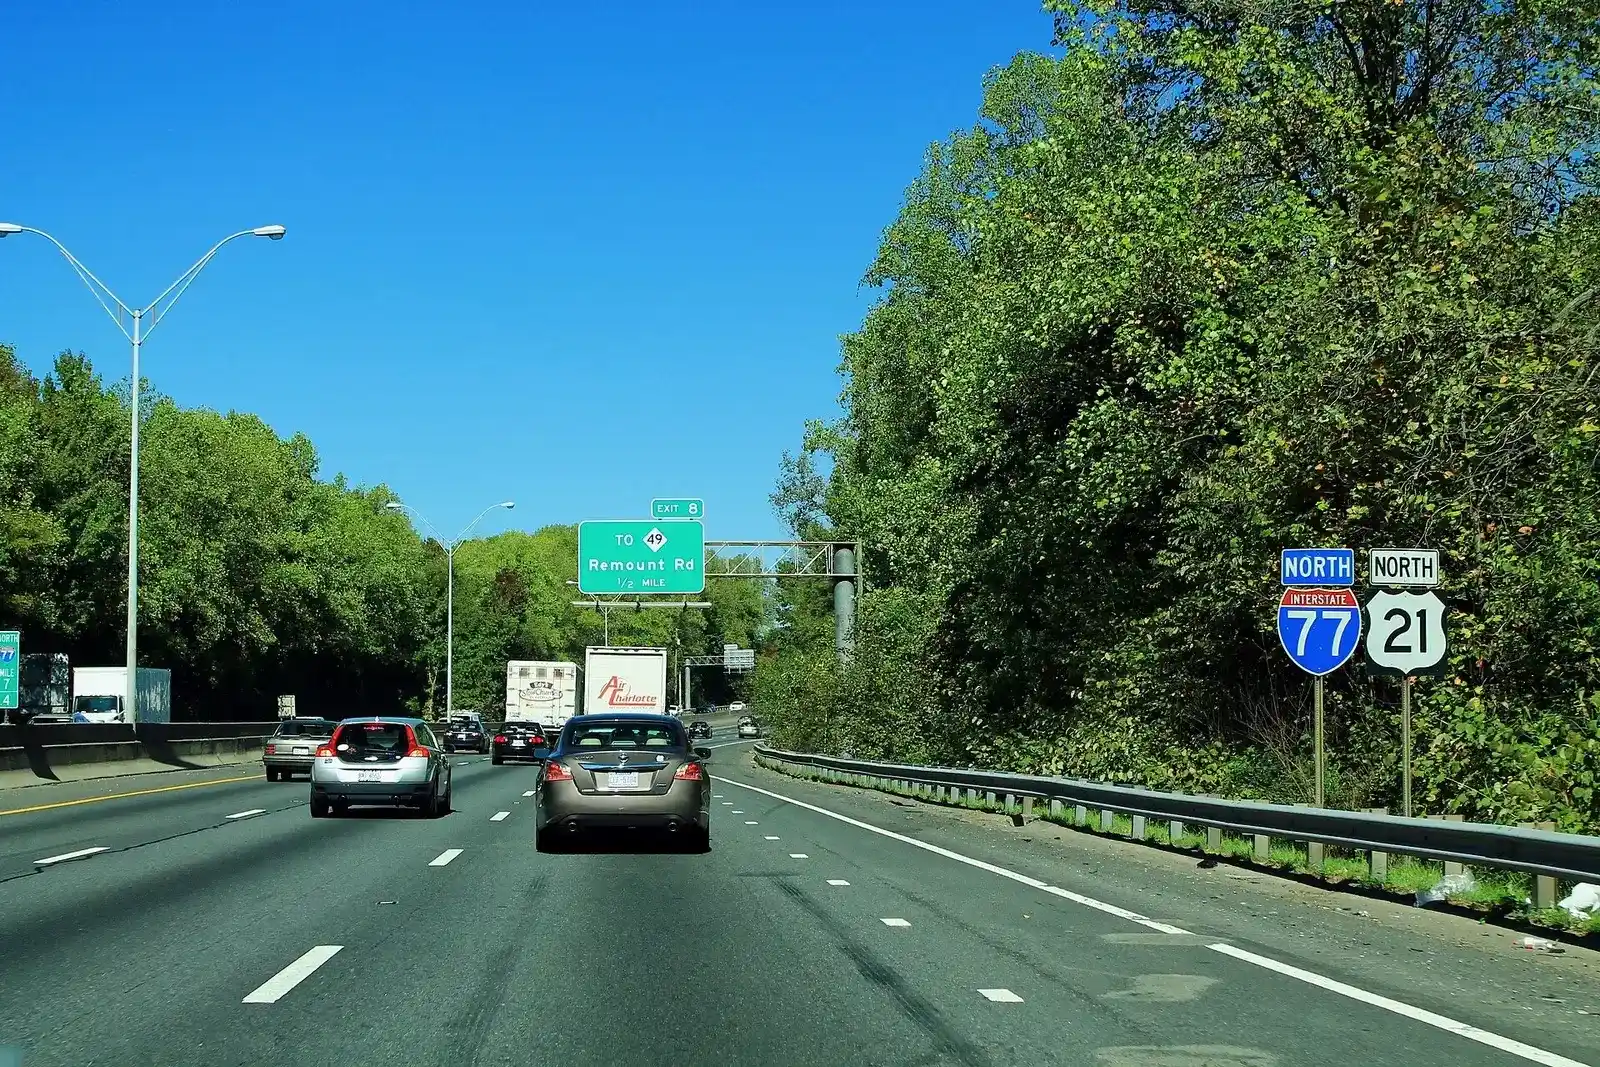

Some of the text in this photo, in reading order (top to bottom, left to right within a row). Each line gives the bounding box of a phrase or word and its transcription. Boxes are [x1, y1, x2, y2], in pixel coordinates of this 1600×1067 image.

[657, 503, 698, 514] EXIT 8
[615, 533, 663, 546] TO 49
[588, 558, 694, 571] Remount Rd
[1285, 556, 1351, 578] NORTH
[1374, 556, 1433, 578] NORTH
[617, 577, 666, 589] 1/2 MILE
[1290, 593, 1347, 605] INTERSTATE
[1287, 610, 1352, 657] 77
[1383, 607, 1427, 653] 21
[1, 650, 14, 660] 77
[3, 678, 10, 690] 7
[597, 675, 627, 699] Air
[608, 688, 657, 706] Charlotte
